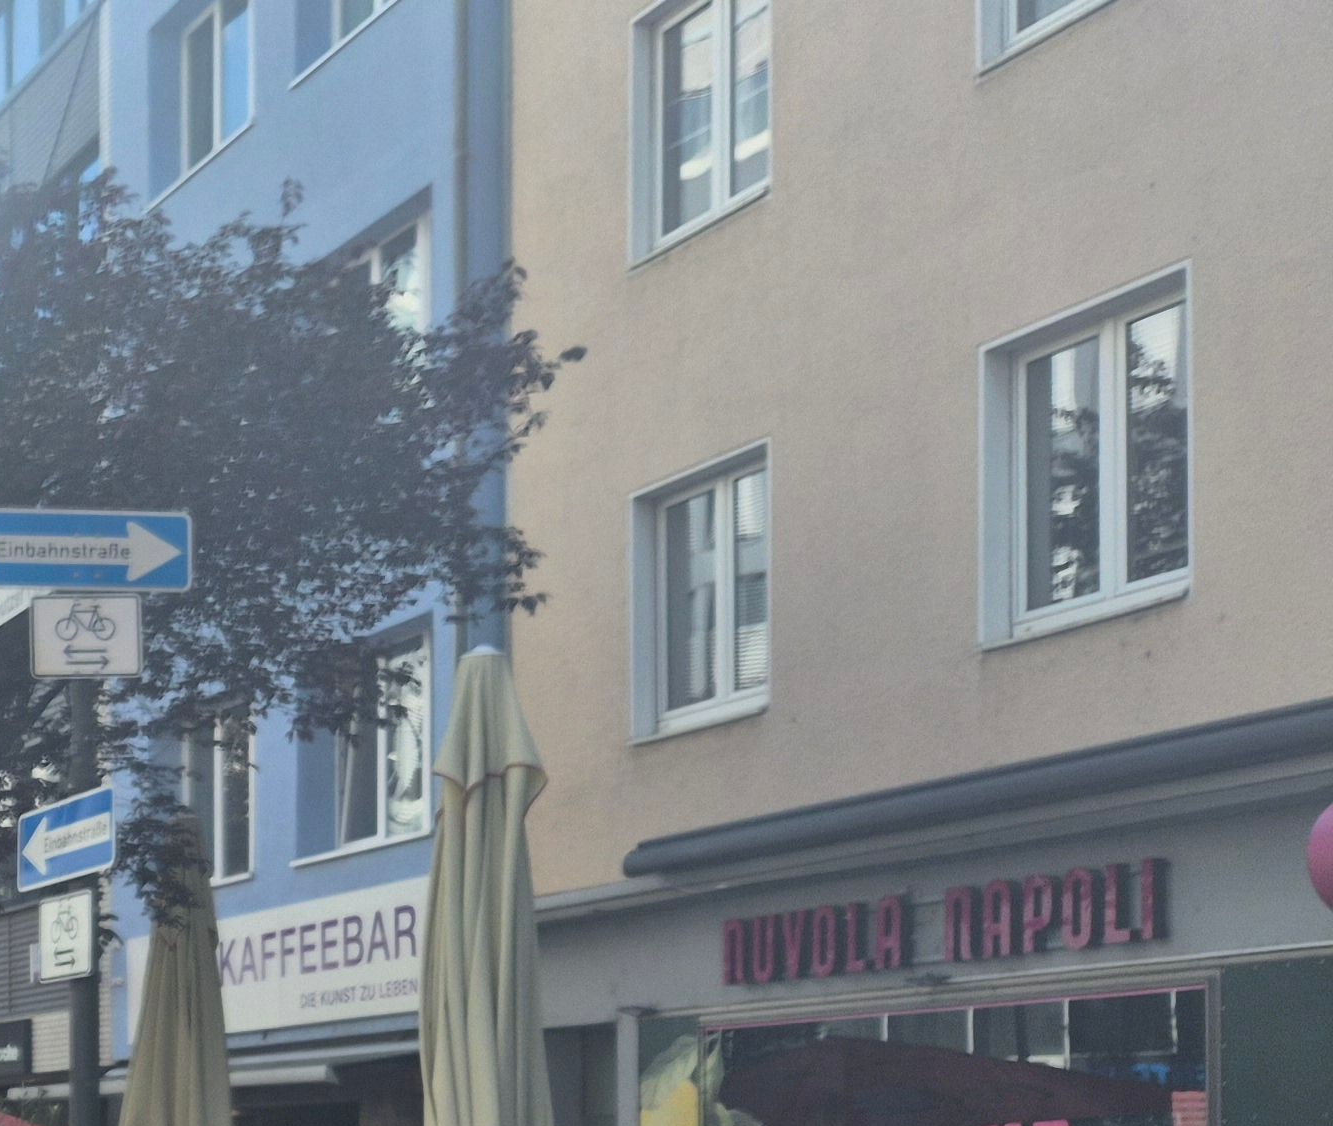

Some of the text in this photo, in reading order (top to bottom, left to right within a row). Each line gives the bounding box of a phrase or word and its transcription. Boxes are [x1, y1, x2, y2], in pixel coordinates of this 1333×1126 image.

[44, 820, 108, 854] Einbahnstraße
[219, 904, 417, 987] KAFFEEBAR
[722, 857, 1155, 986] NUVOLA NAPOLI
[299, 978, 418, 1009] DIE KUNST ZU LEBEN
